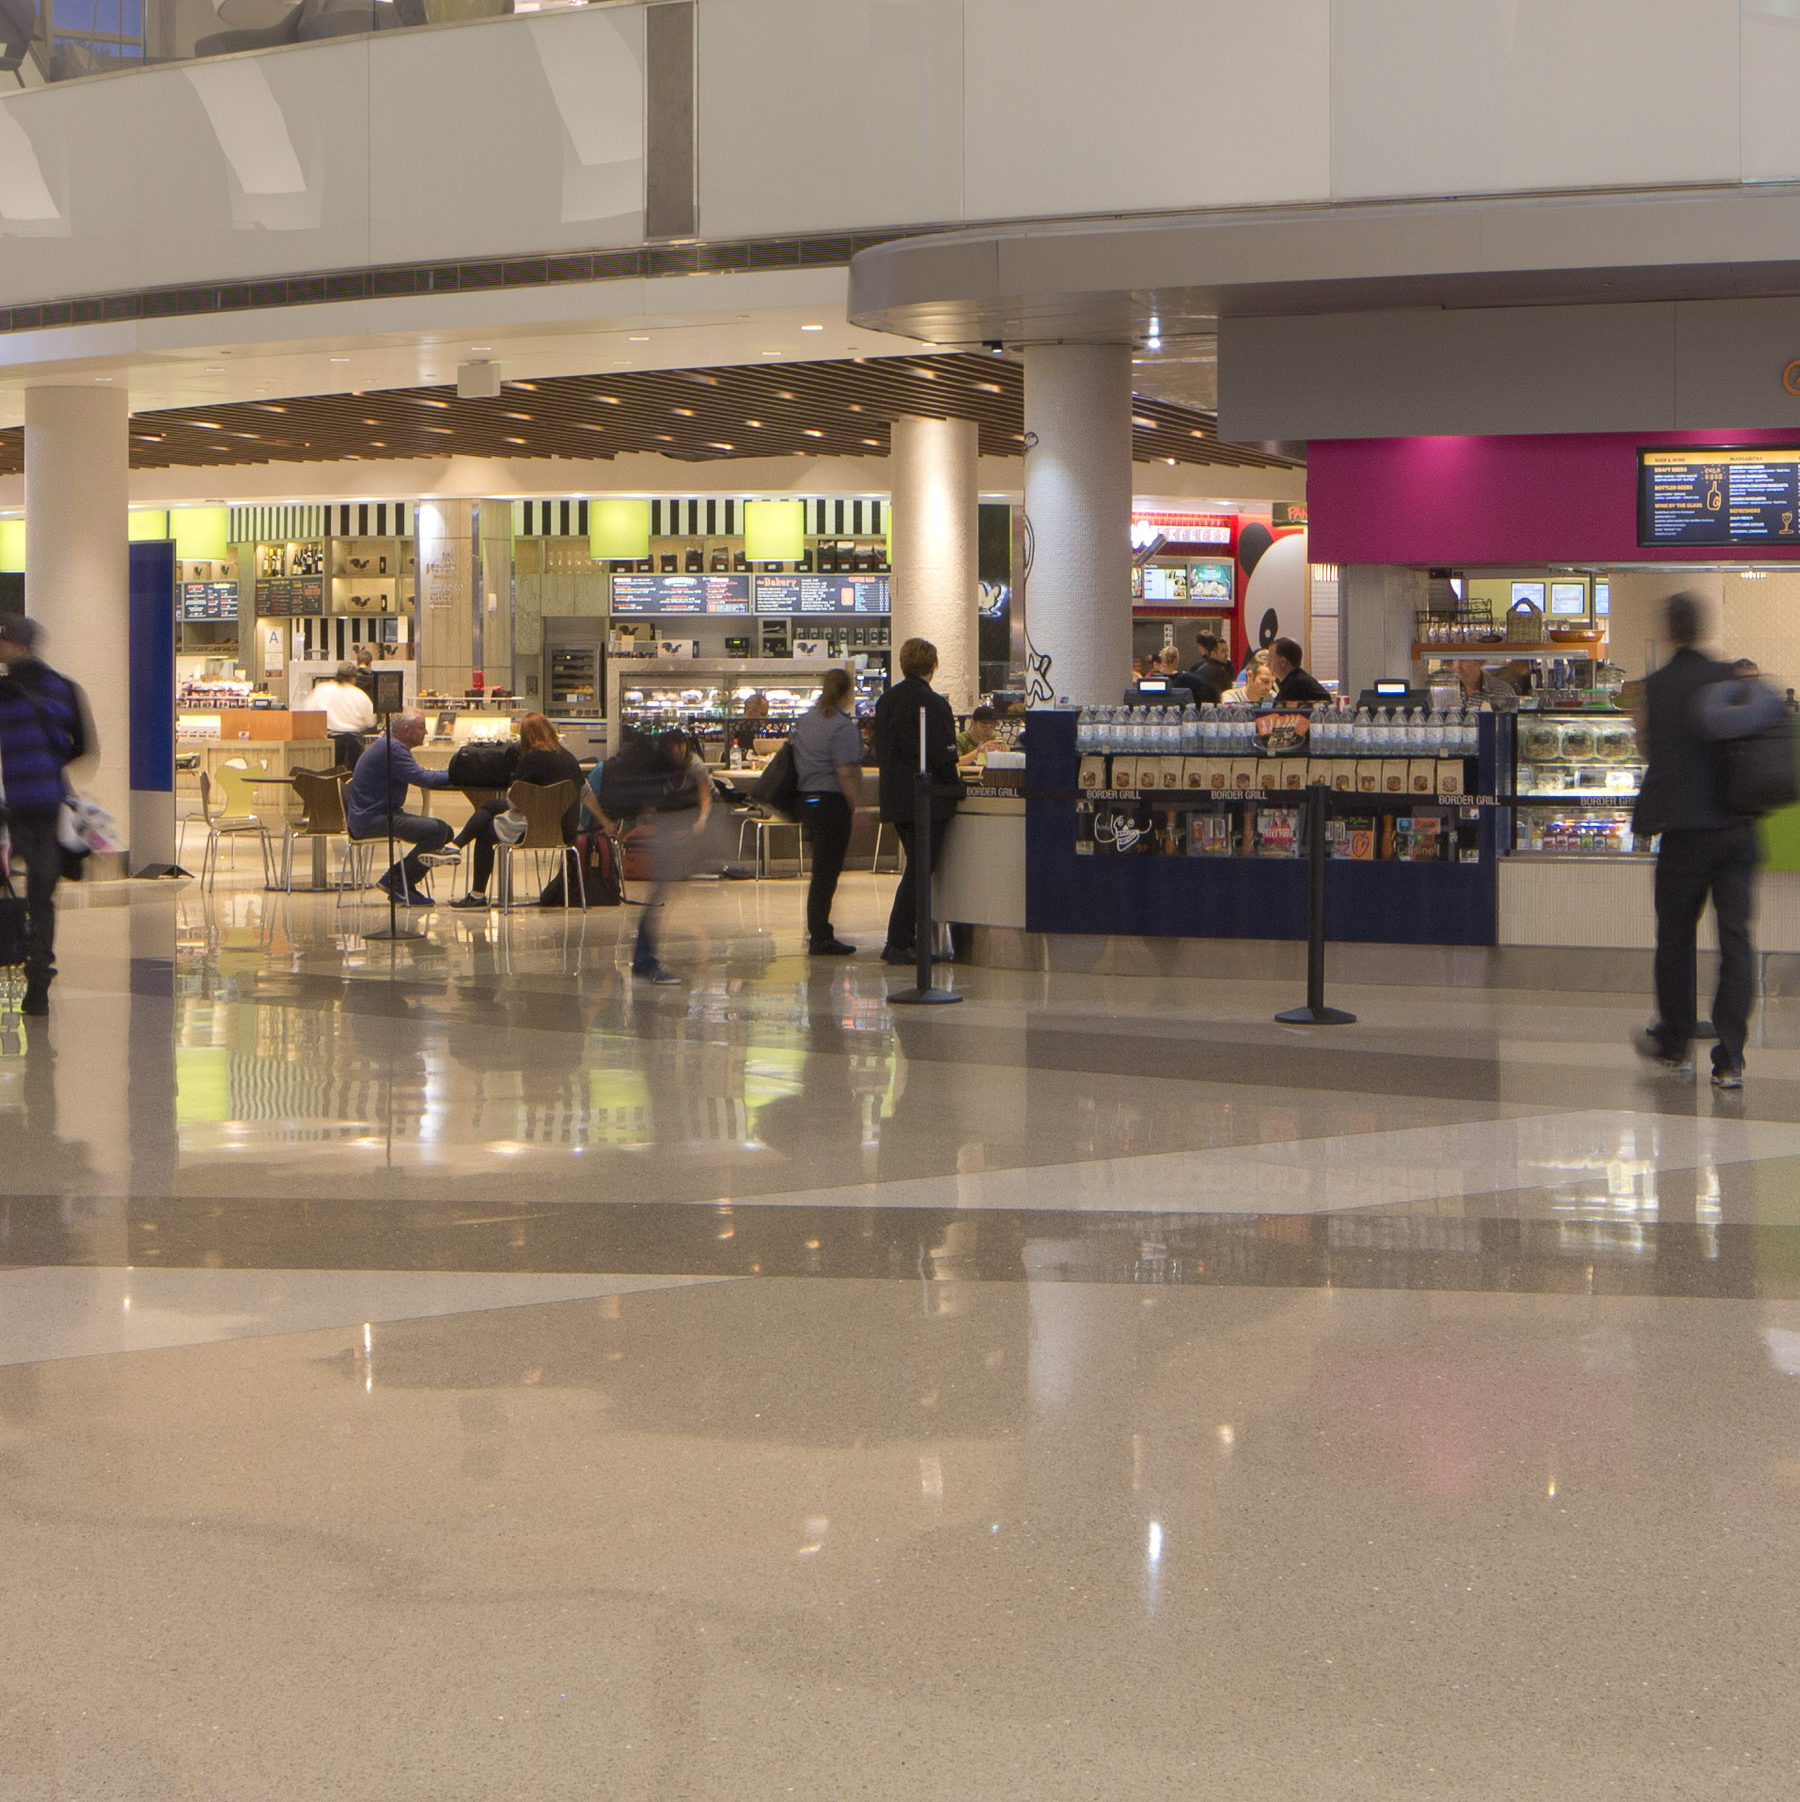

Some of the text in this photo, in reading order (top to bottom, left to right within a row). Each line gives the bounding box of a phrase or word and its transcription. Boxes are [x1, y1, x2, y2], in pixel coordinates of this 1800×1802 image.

[269, 630, 279, 644] A
[966, 786, 1019, 797] BORDER GRILL
[1086, 789, 1141, 800] BORDER GRILL
[1211, 790, 1268, 800] BORDER GRILL
[1438, 795, 1501, 805] BORDER GRILL
[1580, 797, 1617, 807] BORDER
